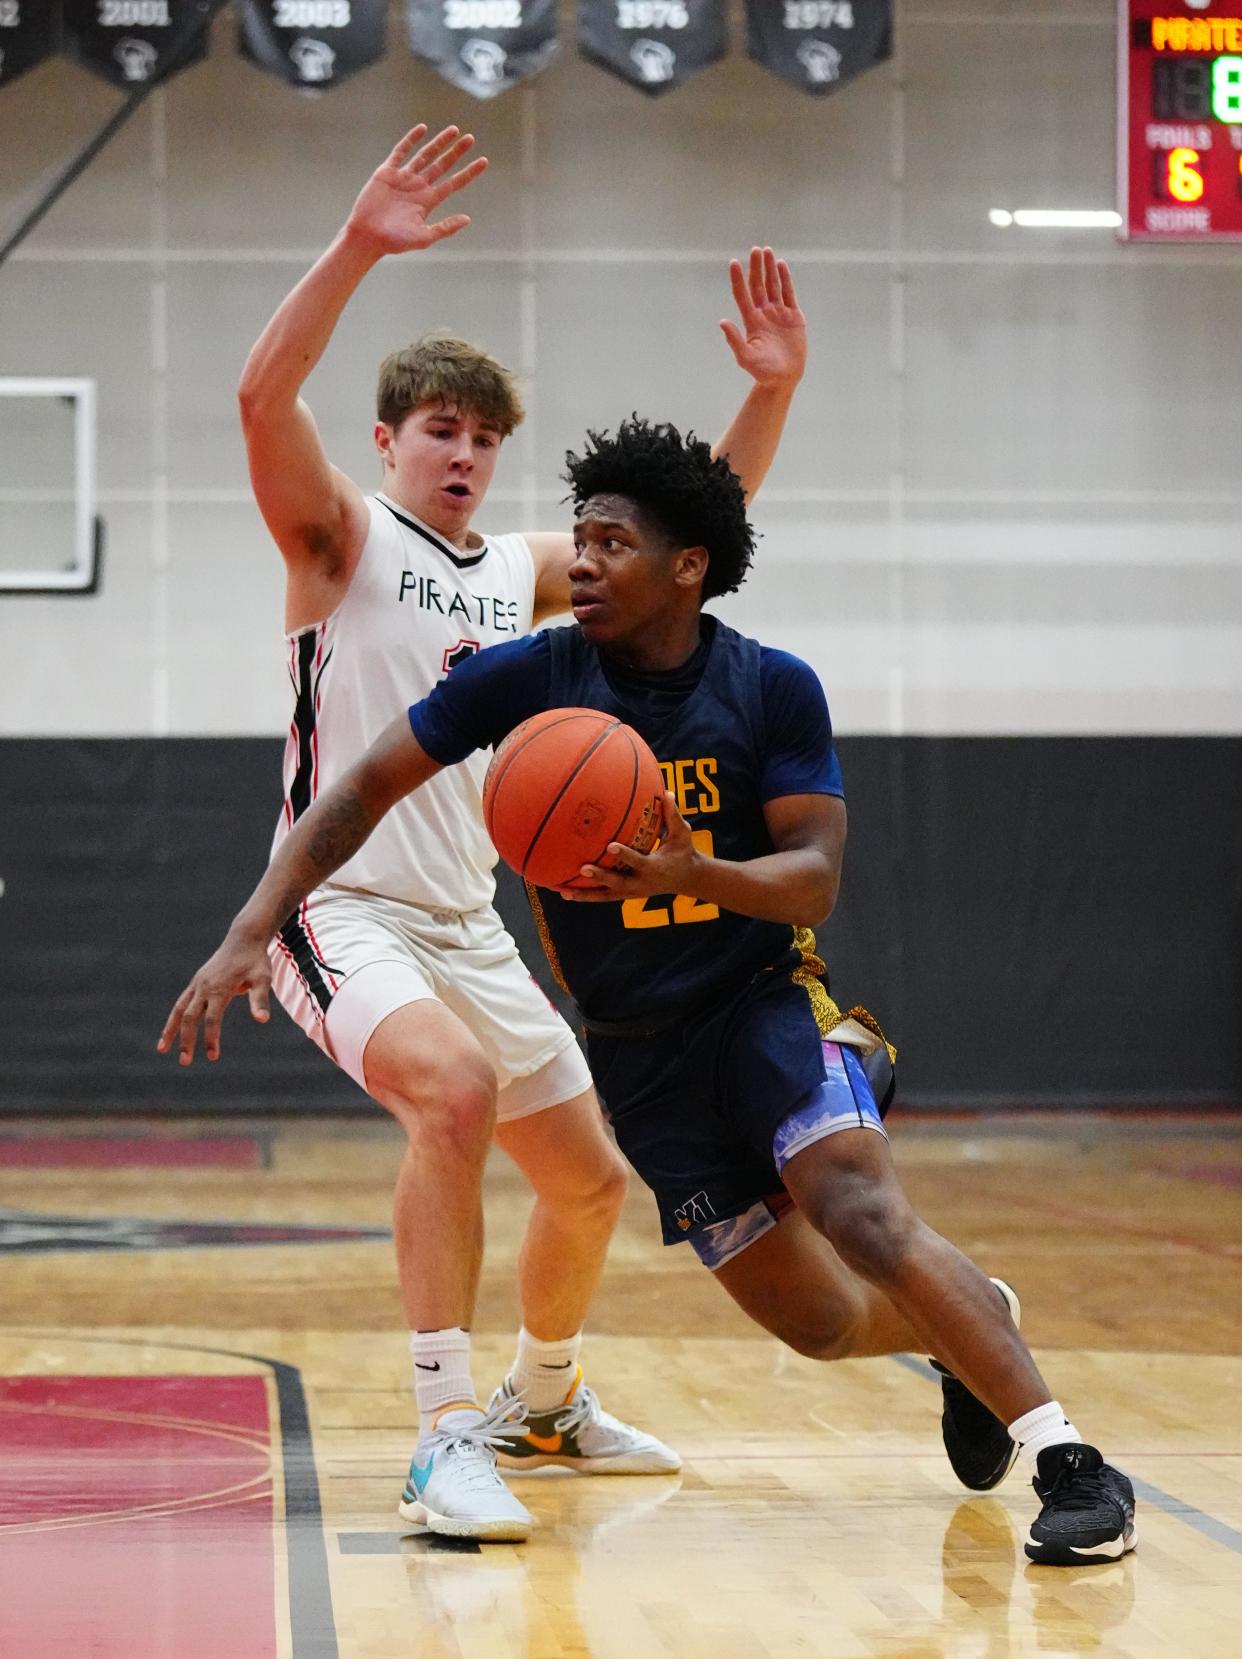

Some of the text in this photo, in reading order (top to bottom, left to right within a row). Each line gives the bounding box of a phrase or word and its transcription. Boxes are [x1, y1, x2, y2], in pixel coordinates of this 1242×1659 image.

[615, 0, 689, 28] 1976
[782, 0, 854, 28] 1974
[1146, 124, 1212, 150] FOULS
[1168, 147, 1203, 201] 6
[1146, 207, 1210, 231] SCORE
[399, 571, 518, 633] PIRATES
